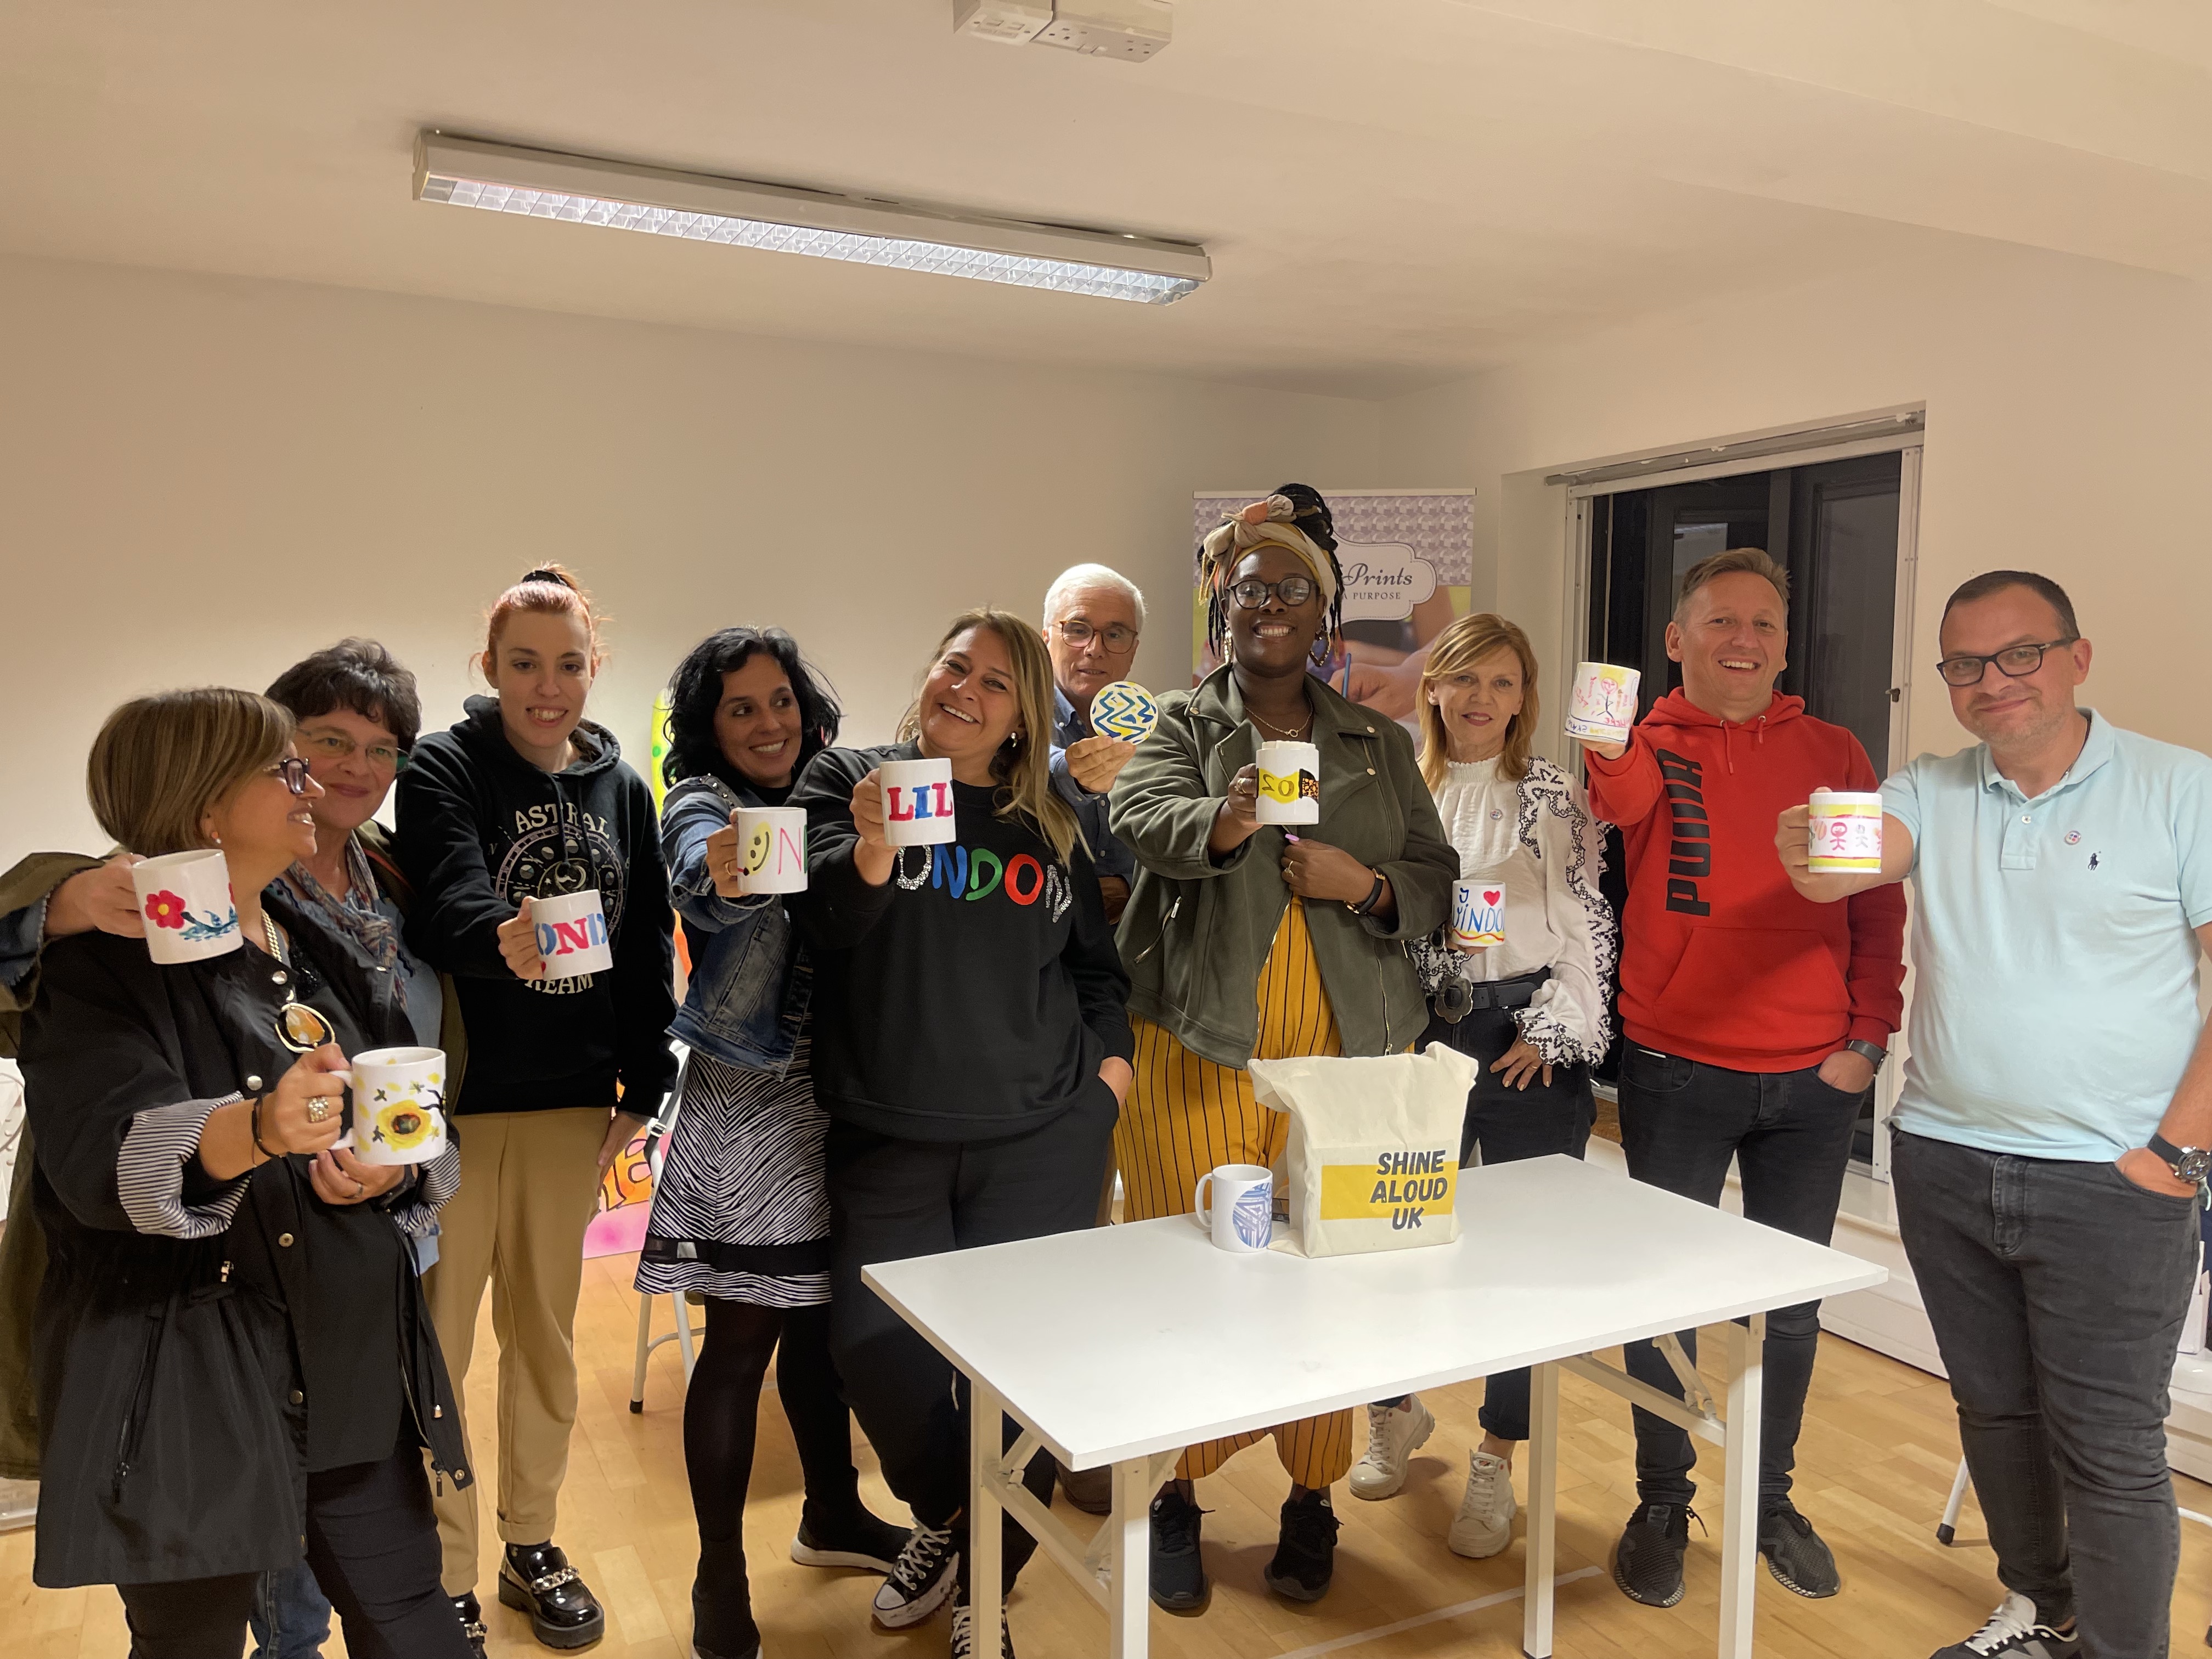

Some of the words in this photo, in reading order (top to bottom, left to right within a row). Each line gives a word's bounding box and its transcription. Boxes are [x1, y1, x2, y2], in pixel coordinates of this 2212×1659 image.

[1342, 563, 1413, 586] Prints
[887, 780, 953, 821] LIL
[515, 802, 610, 839] ASTRAL
[1657, 748, 1711, 916] PUMA
[896, 843, 1073, 923] ONDON
[1376, 1150, 1446, 1175] SHINE
[1369, 1177, 1448, 1203] ALOUD
[1392, 1206, 1425, 1230] UK
